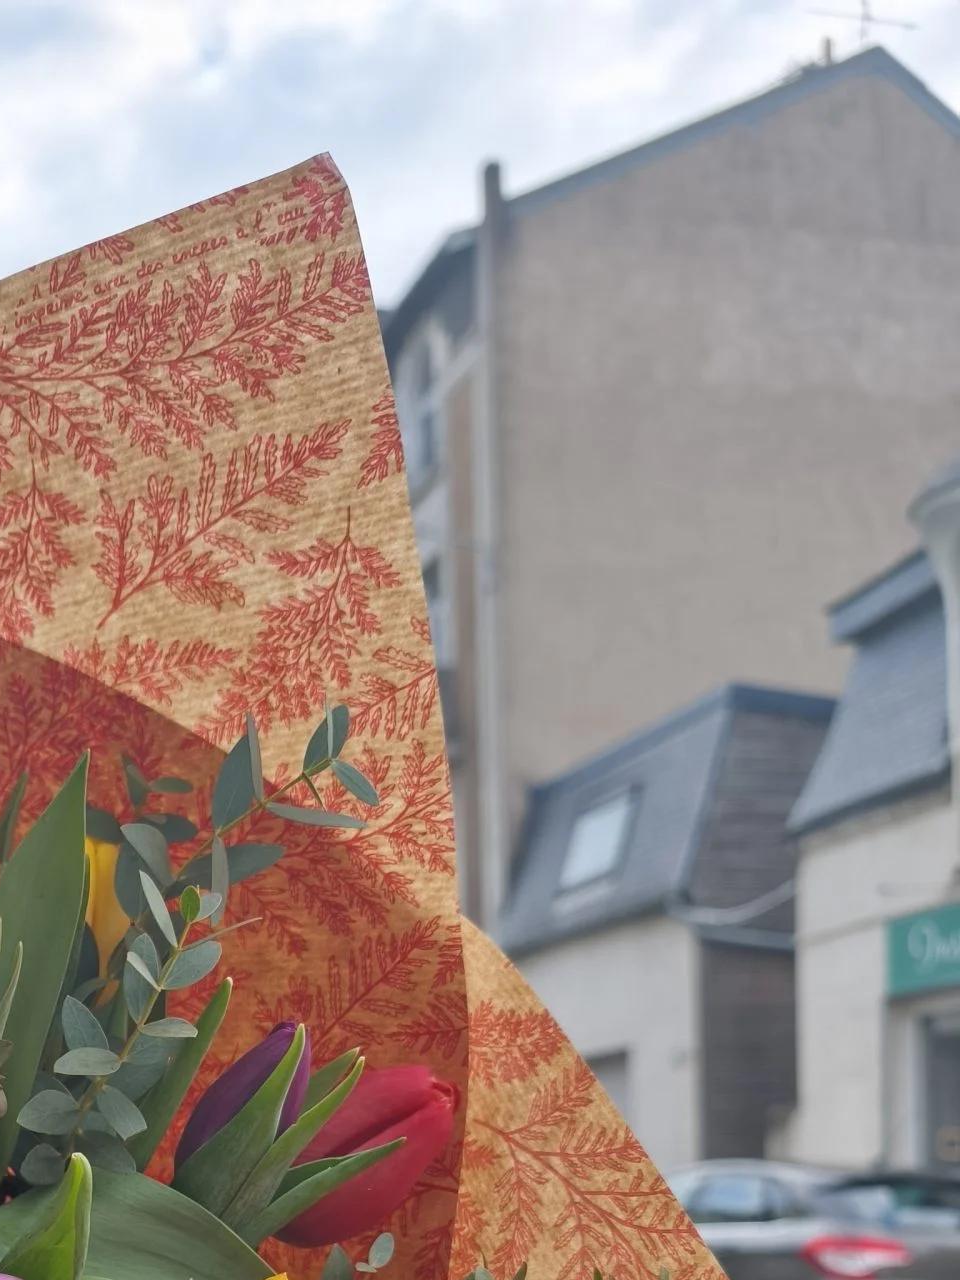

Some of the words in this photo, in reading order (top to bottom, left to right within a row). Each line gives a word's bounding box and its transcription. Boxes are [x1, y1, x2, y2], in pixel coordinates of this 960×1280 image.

[14, 280, 89, 328] imprimé
[93, 274, 129, 297] avec
[136, 260, 164, 279] des
[172, 234, 228, 265] encres
